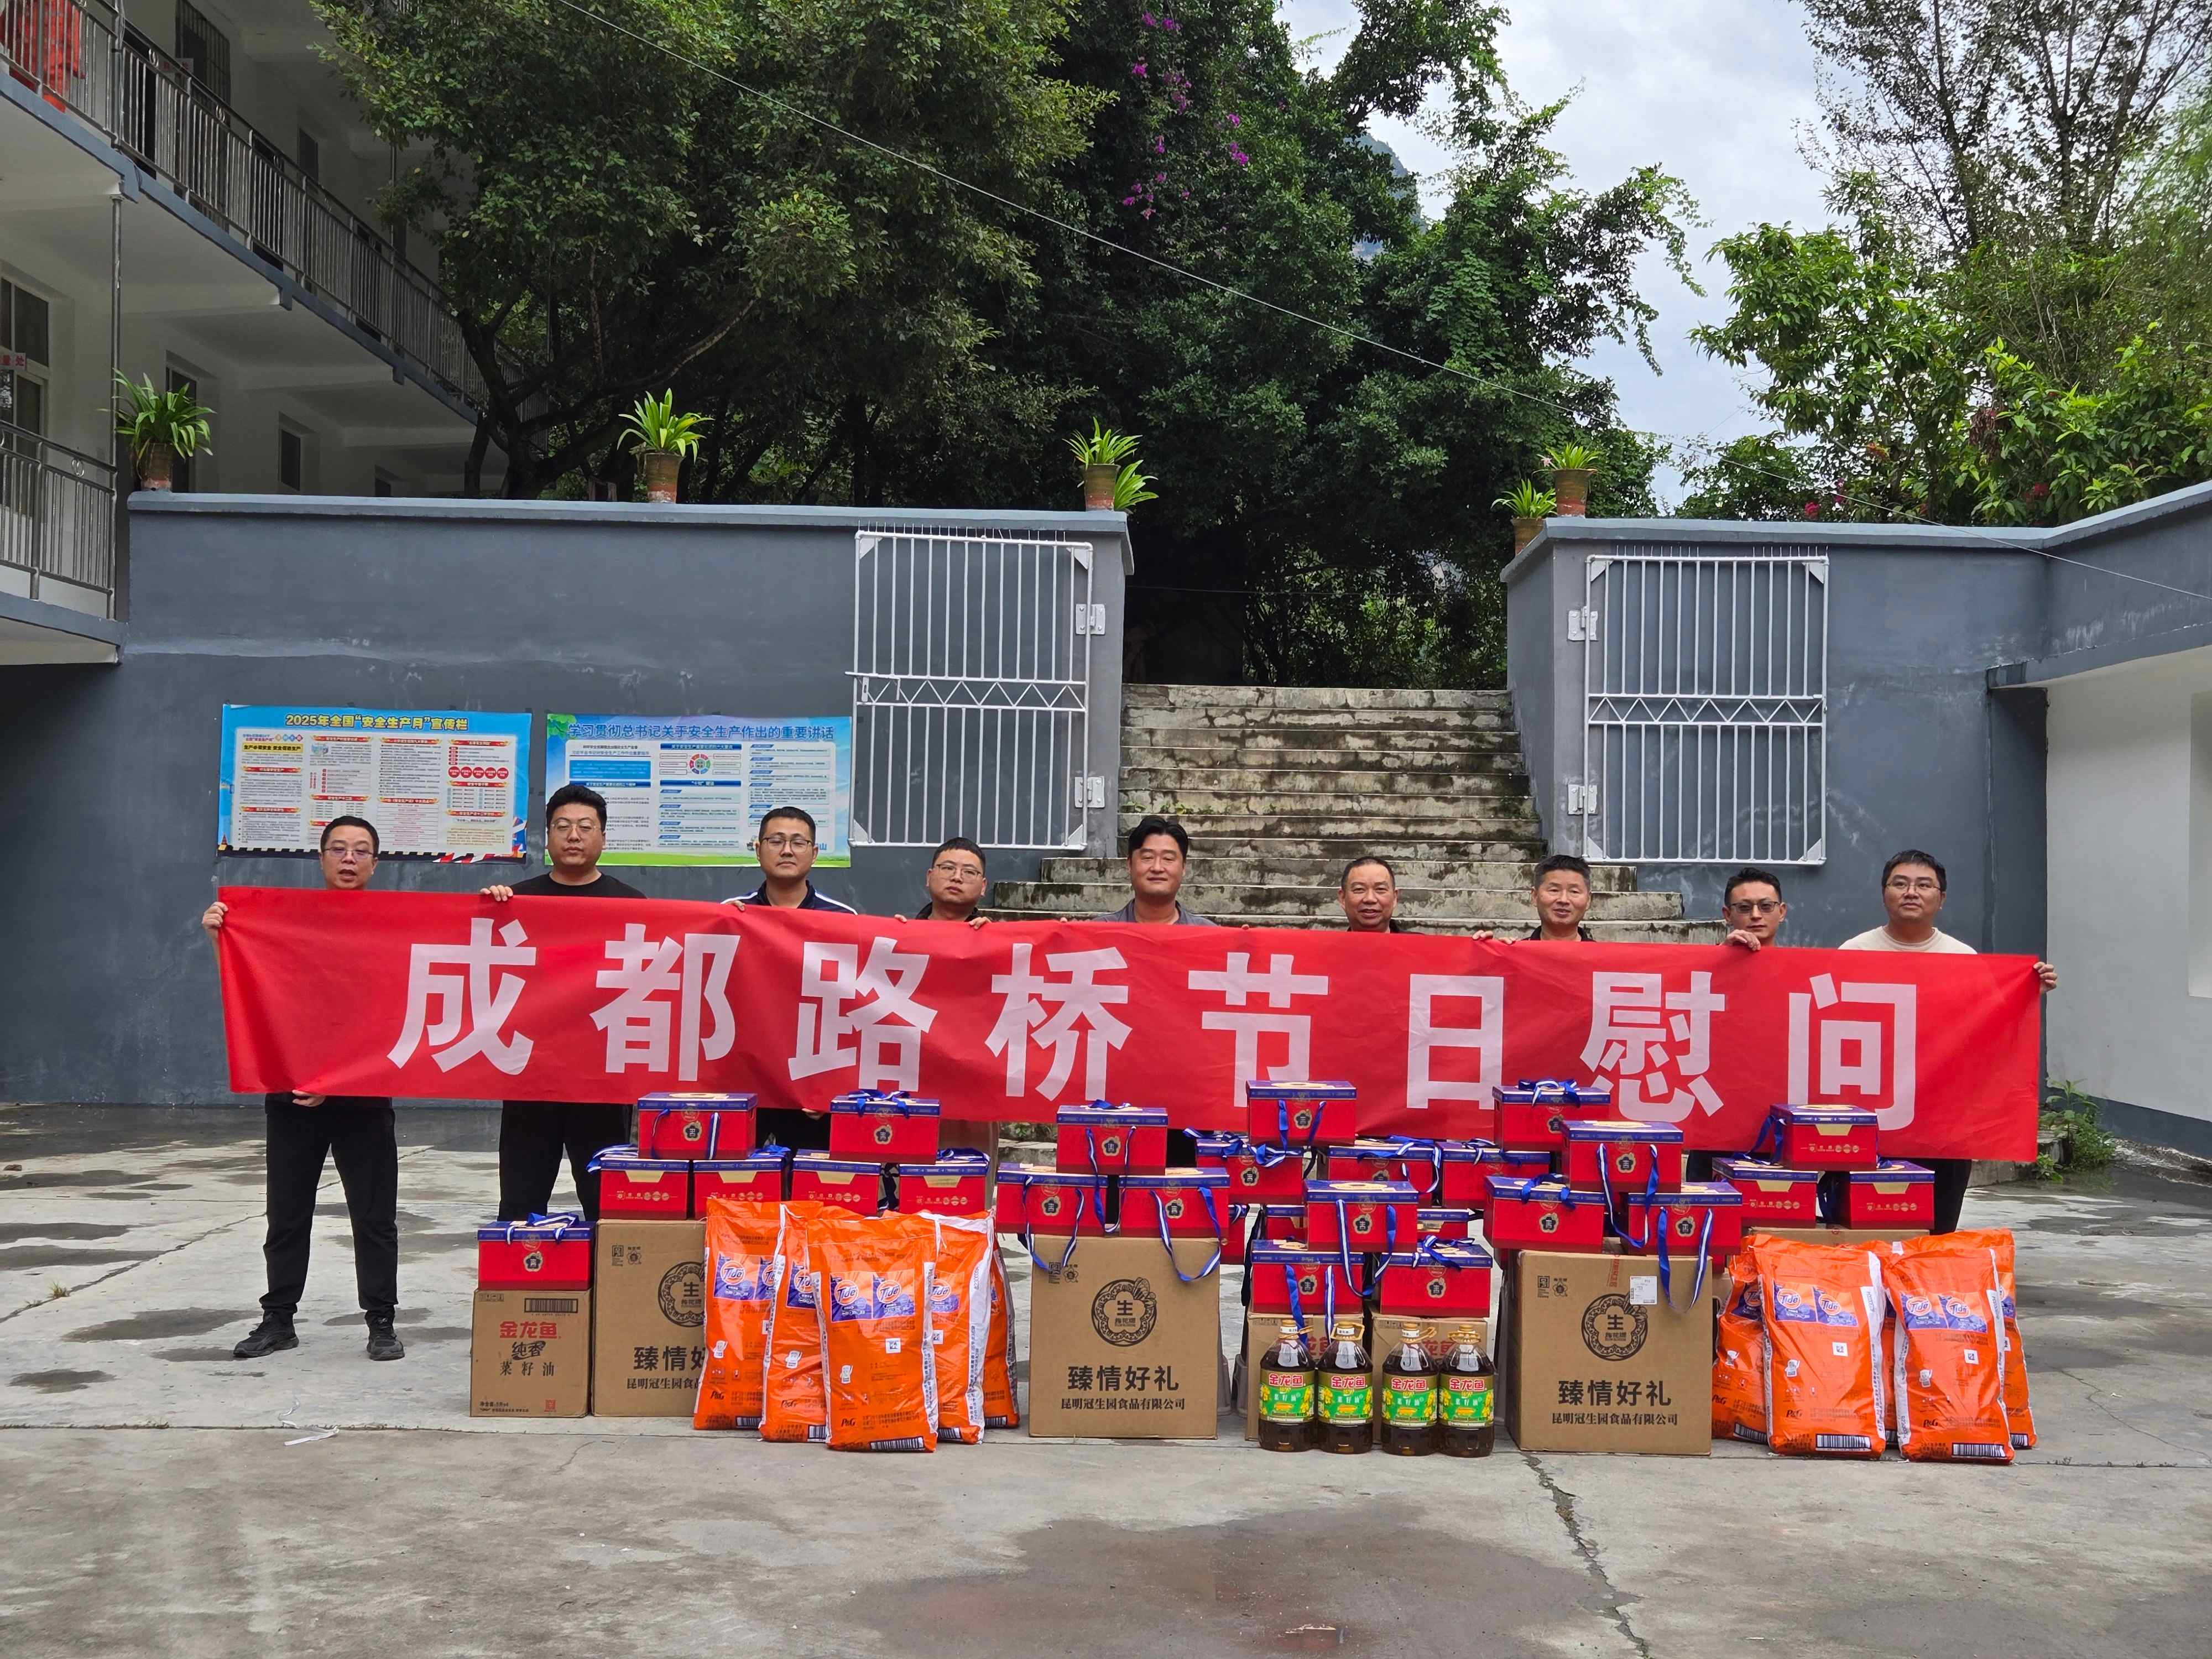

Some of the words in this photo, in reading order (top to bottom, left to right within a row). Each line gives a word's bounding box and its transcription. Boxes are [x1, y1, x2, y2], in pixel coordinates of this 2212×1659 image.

[568, 724, 834, 739] 学习贯彻总书记关于安全生产作出的重要讲话
[387, 917, 1917, 1131] 成都路桥节日慰问
[837, 1287, 856, 1301] Tide
[880, 1285, 899, 1300] Tide
[1780, 1295, 1798, 1304] Tide
[1821, 1300, 1838, 1310] Tide
[500, 1321, 557, 1339] 金龙鱼
[512, 1340, 546, 1360] 纯香
[634, 1346, 705, 1371] 臻情好
[500, 1361, 554, 1376] 菜籽油
[627, 1378, 701, 1390] 昆明冠生园食品
[1068, 1366, 1179, 1391] 臻情好礼
[1269, 1373, 1303, 1387] 金龙鱼
[1331, 1375, 1366, 1389] 金龙鱼
[1391, 1378, 1427, 1391] 金龙鱼
[1449, 1378, 1485, 1391] 金龙鱼
[1558, 1380, 1672, 1406] 臻情好礼
[1061, 1398, 1185, 1410] 昆明冠生园食品有限公司
[841, 1418, 855, 1427] P&G
[1552, 1412, 1678, 1425] 昆明冠生园食品有限公司
